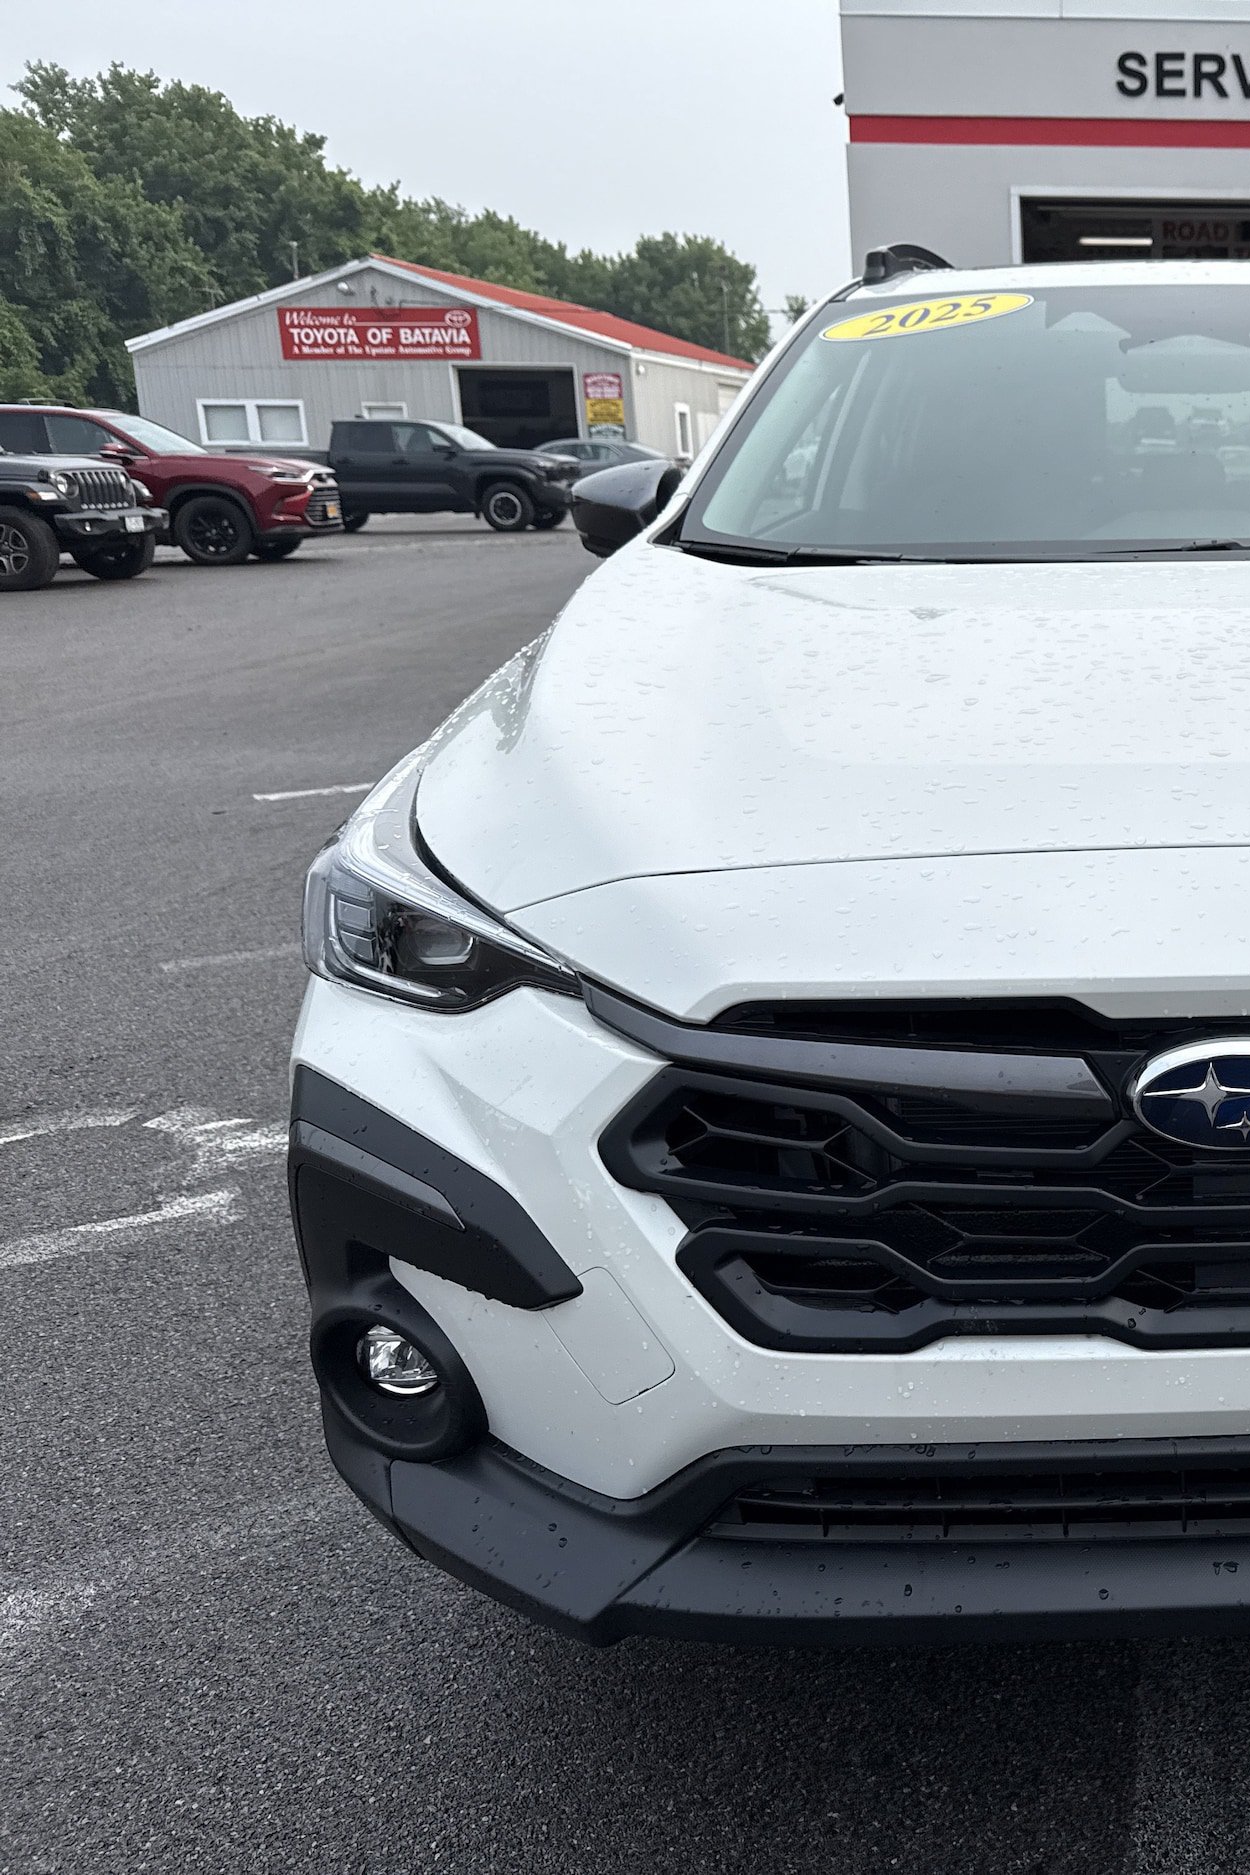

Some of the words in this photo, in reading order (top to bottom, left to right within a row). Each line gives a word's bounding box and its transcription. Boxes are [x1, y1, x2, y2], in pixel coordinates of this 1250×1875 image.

[1162, 220, 1229, 241] ROAD
[285, 311, 340, 326] Welcome
[343, 312, 357, 326] to
[861, 296, 997, 336] 2025
[289, 328, 360, 345] TOYOTA
[367, 328, 393, 345] OF
[400, 328, 472, 345] BATAVIA
